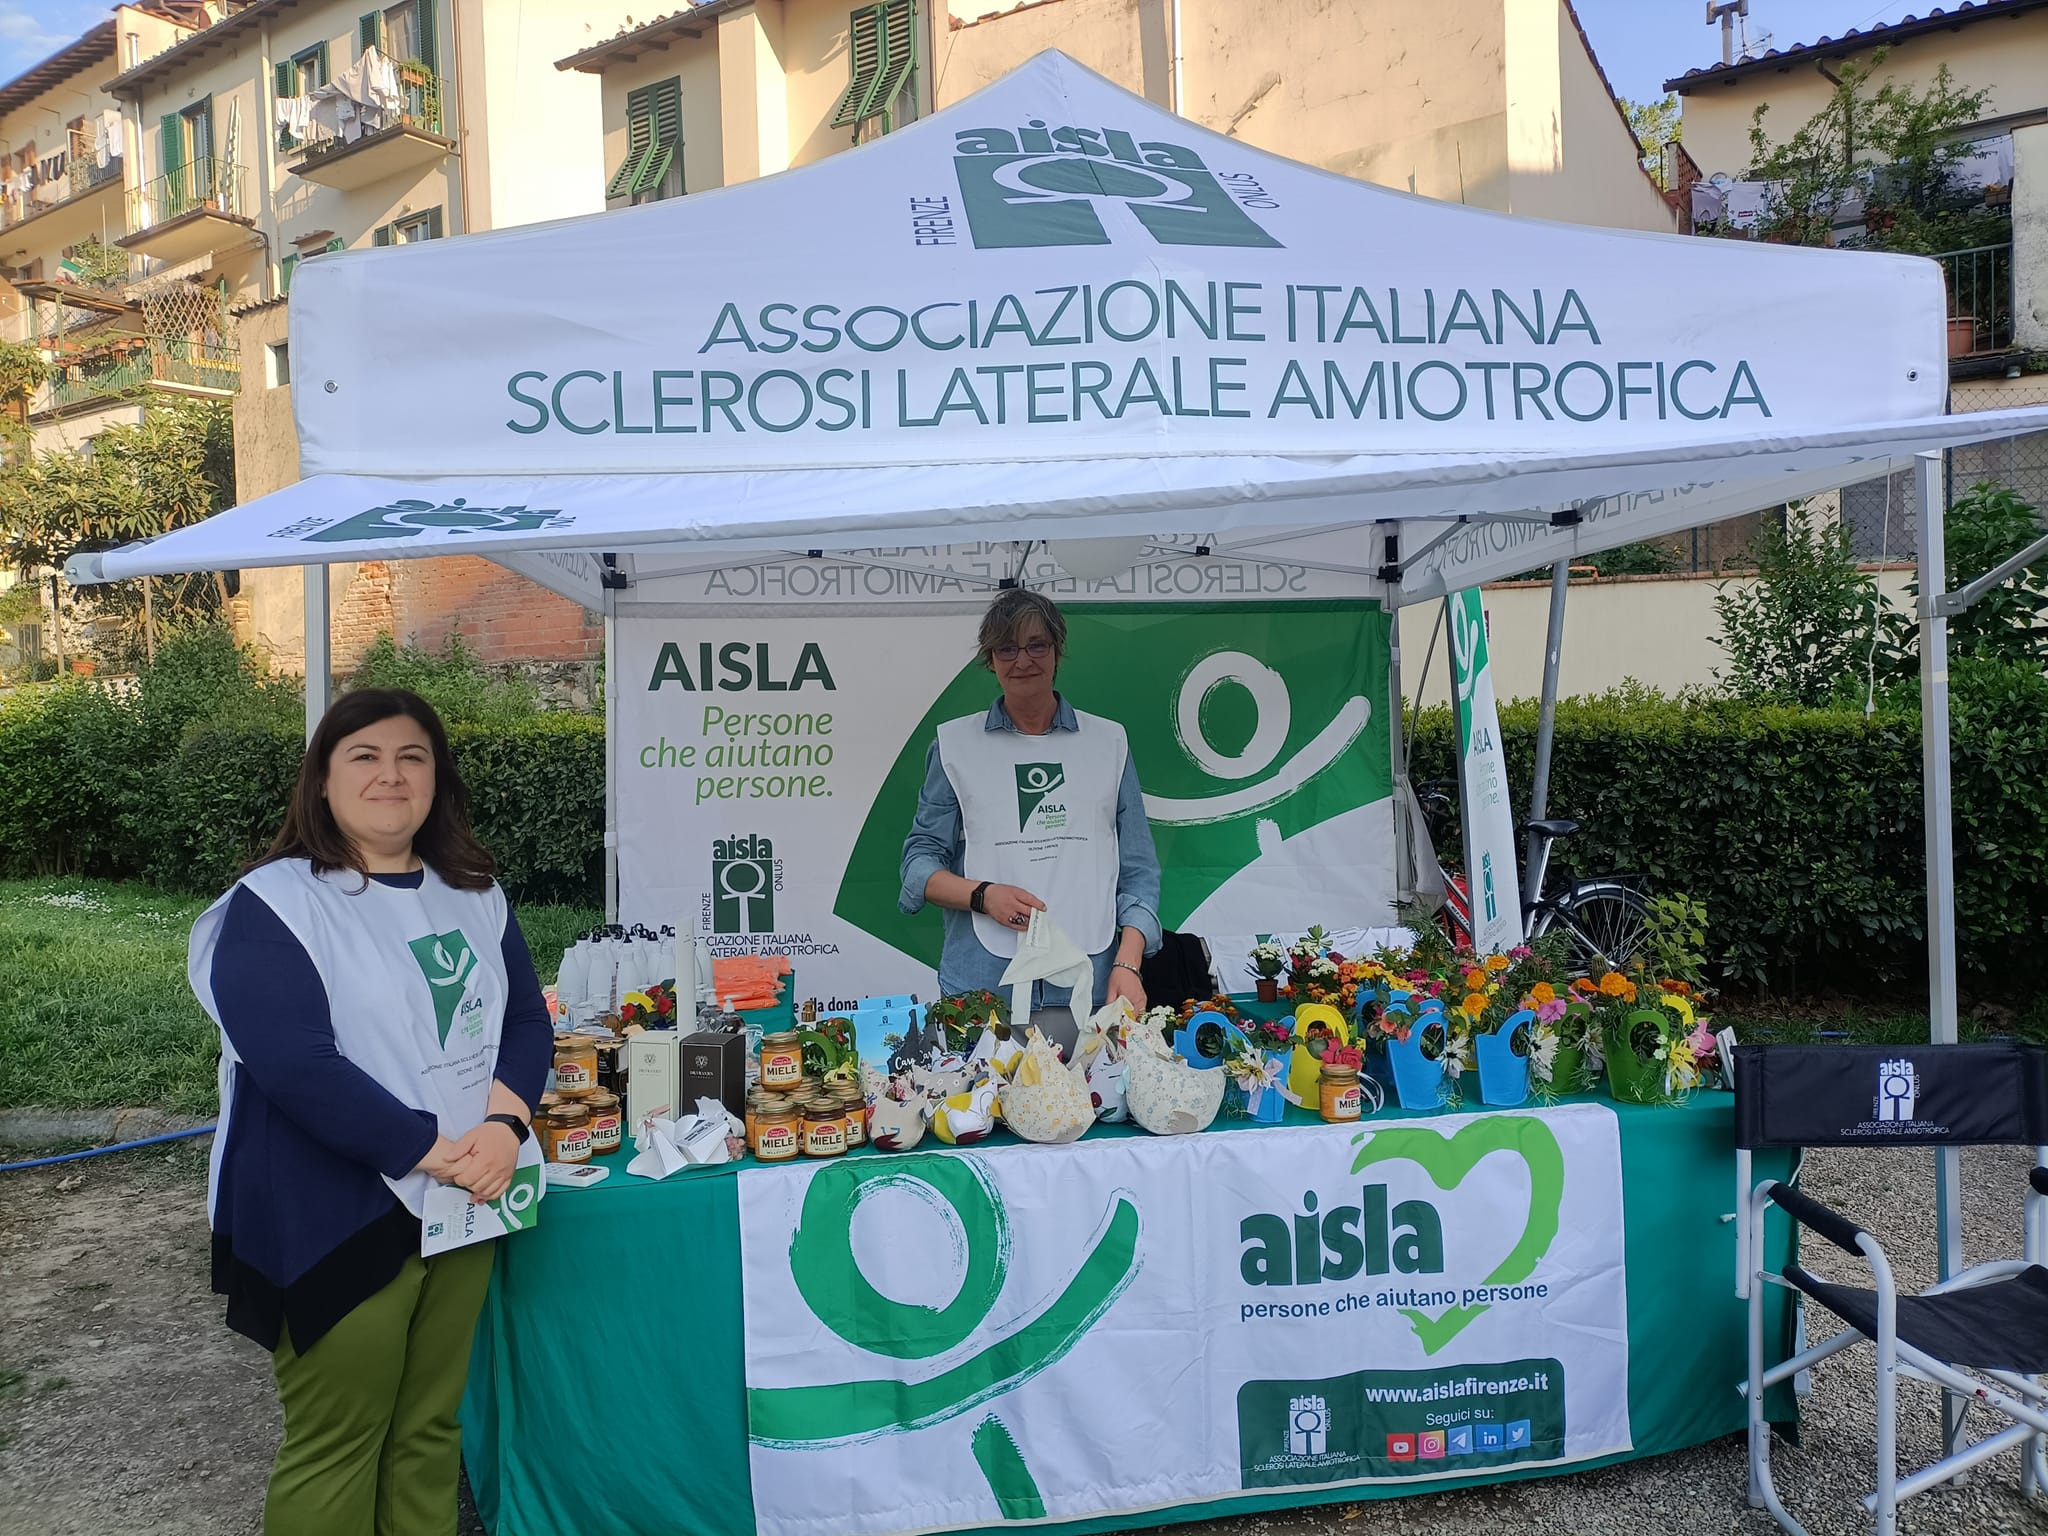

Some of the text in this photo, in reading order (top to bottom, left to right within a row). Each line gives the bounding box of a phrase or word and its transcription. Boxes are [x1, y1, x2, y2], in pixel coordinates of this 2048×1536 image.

[955, 119, 1209, 170] aisla
[1218, 171, 1280, 210] ONLUS
[911, 196, 957, 246] FIRENZE
[697, 279, 1602, 354] ASSOCIAZIONE ITALIANA
[505, 357, 1773, 435] SCLEROSI LATERALE AMIOTROFICA
[647, 641, 837, 692] AISLA
[702, 705, 834, 737] Persone
[639, 736, 834, 768] che aiutano
[695, 774, 833, 806] persone.
[1037, 803, 1066, 814] AISLA
[712, 833, 773, 860] aisla
[774, 858, 783, 891] ONLUS
[702, 892, 711, 931] FIRENZE
[694, 933, 813, 947] CIAZIONE ITALIANA
[710, 943, 840, 958] ATERALE AMIOTROFICA
[766, 1064, 798, 1076] MIELE
[1879, 1058, 1914, 1076] aisla
[591, 1126, 620, 1140] MIELE
[761, 1136, 794, 1149] MIELE
[810, 1134, 842, 1146] MIELE
[1840, 1126, 1950, 1136] SCLEROSI LATERALE AMIOTROFICA
[561, 1139, 592, 1153] MIELE
[464, 1202, 475, 1239] AISLA
[1240, 1183, 1444, 1287] aisla
[1240, 1284, 1549, 1323] persone che aiutano persone
[1365, 1372, 1549, 1403] www.aislafirenze.it
[1289, 1395, 1326, 1411] aisla
[1425, 1408, 1495, 1427] Seguici su:
[1253, 1454, 1361, 1472] SCLEROSI LATERALE AMIOTROFICA
[1268, 1450, 1347, 1463] ASSOCIAZIONE ITALIANA
